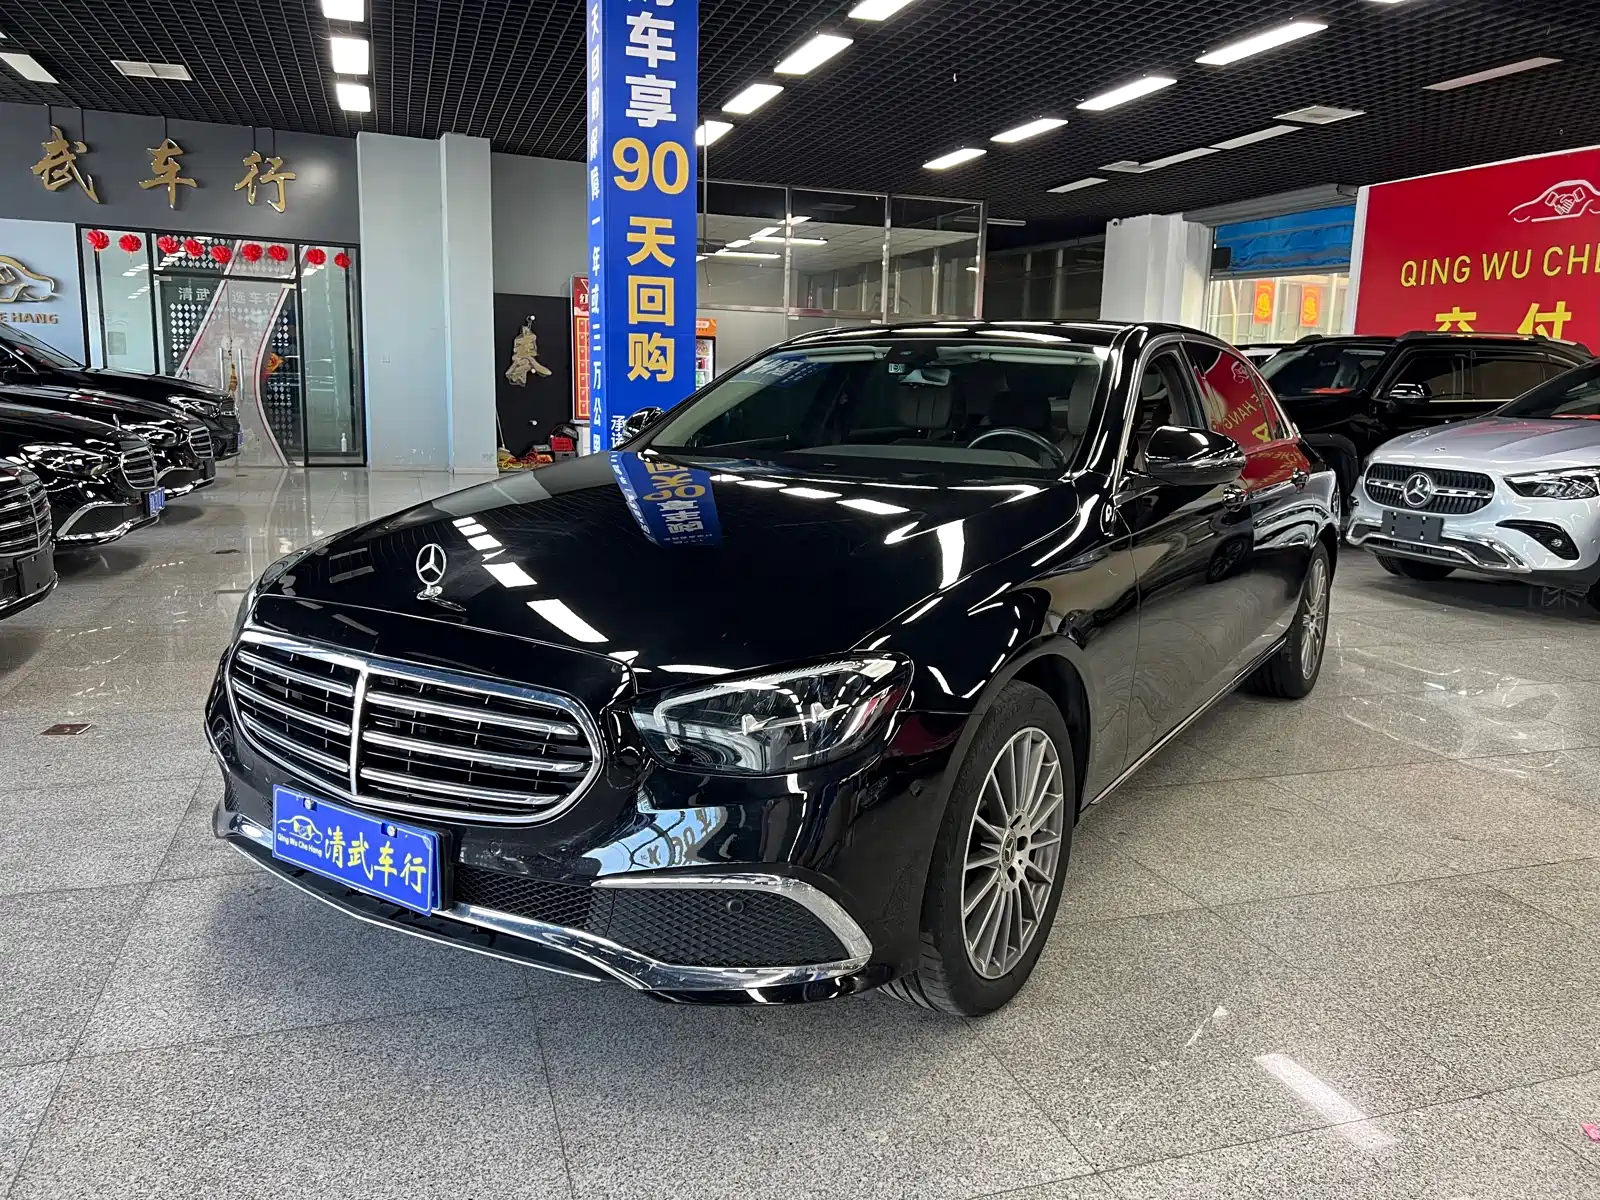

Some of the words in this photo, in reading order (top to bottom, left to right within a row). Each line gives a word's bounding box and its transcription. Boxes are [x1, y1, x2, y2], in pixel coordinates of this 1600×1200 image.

[31, 125, 296, 213] 武车行
[613, 0, 689, 382] 车享90天回购
[1400, 254, 1471, 287] QING
[1482, 249, 1532, 281] WU
[11, 312, 59, 324] HANG
[325, 825, 427, 894] 清武车行
